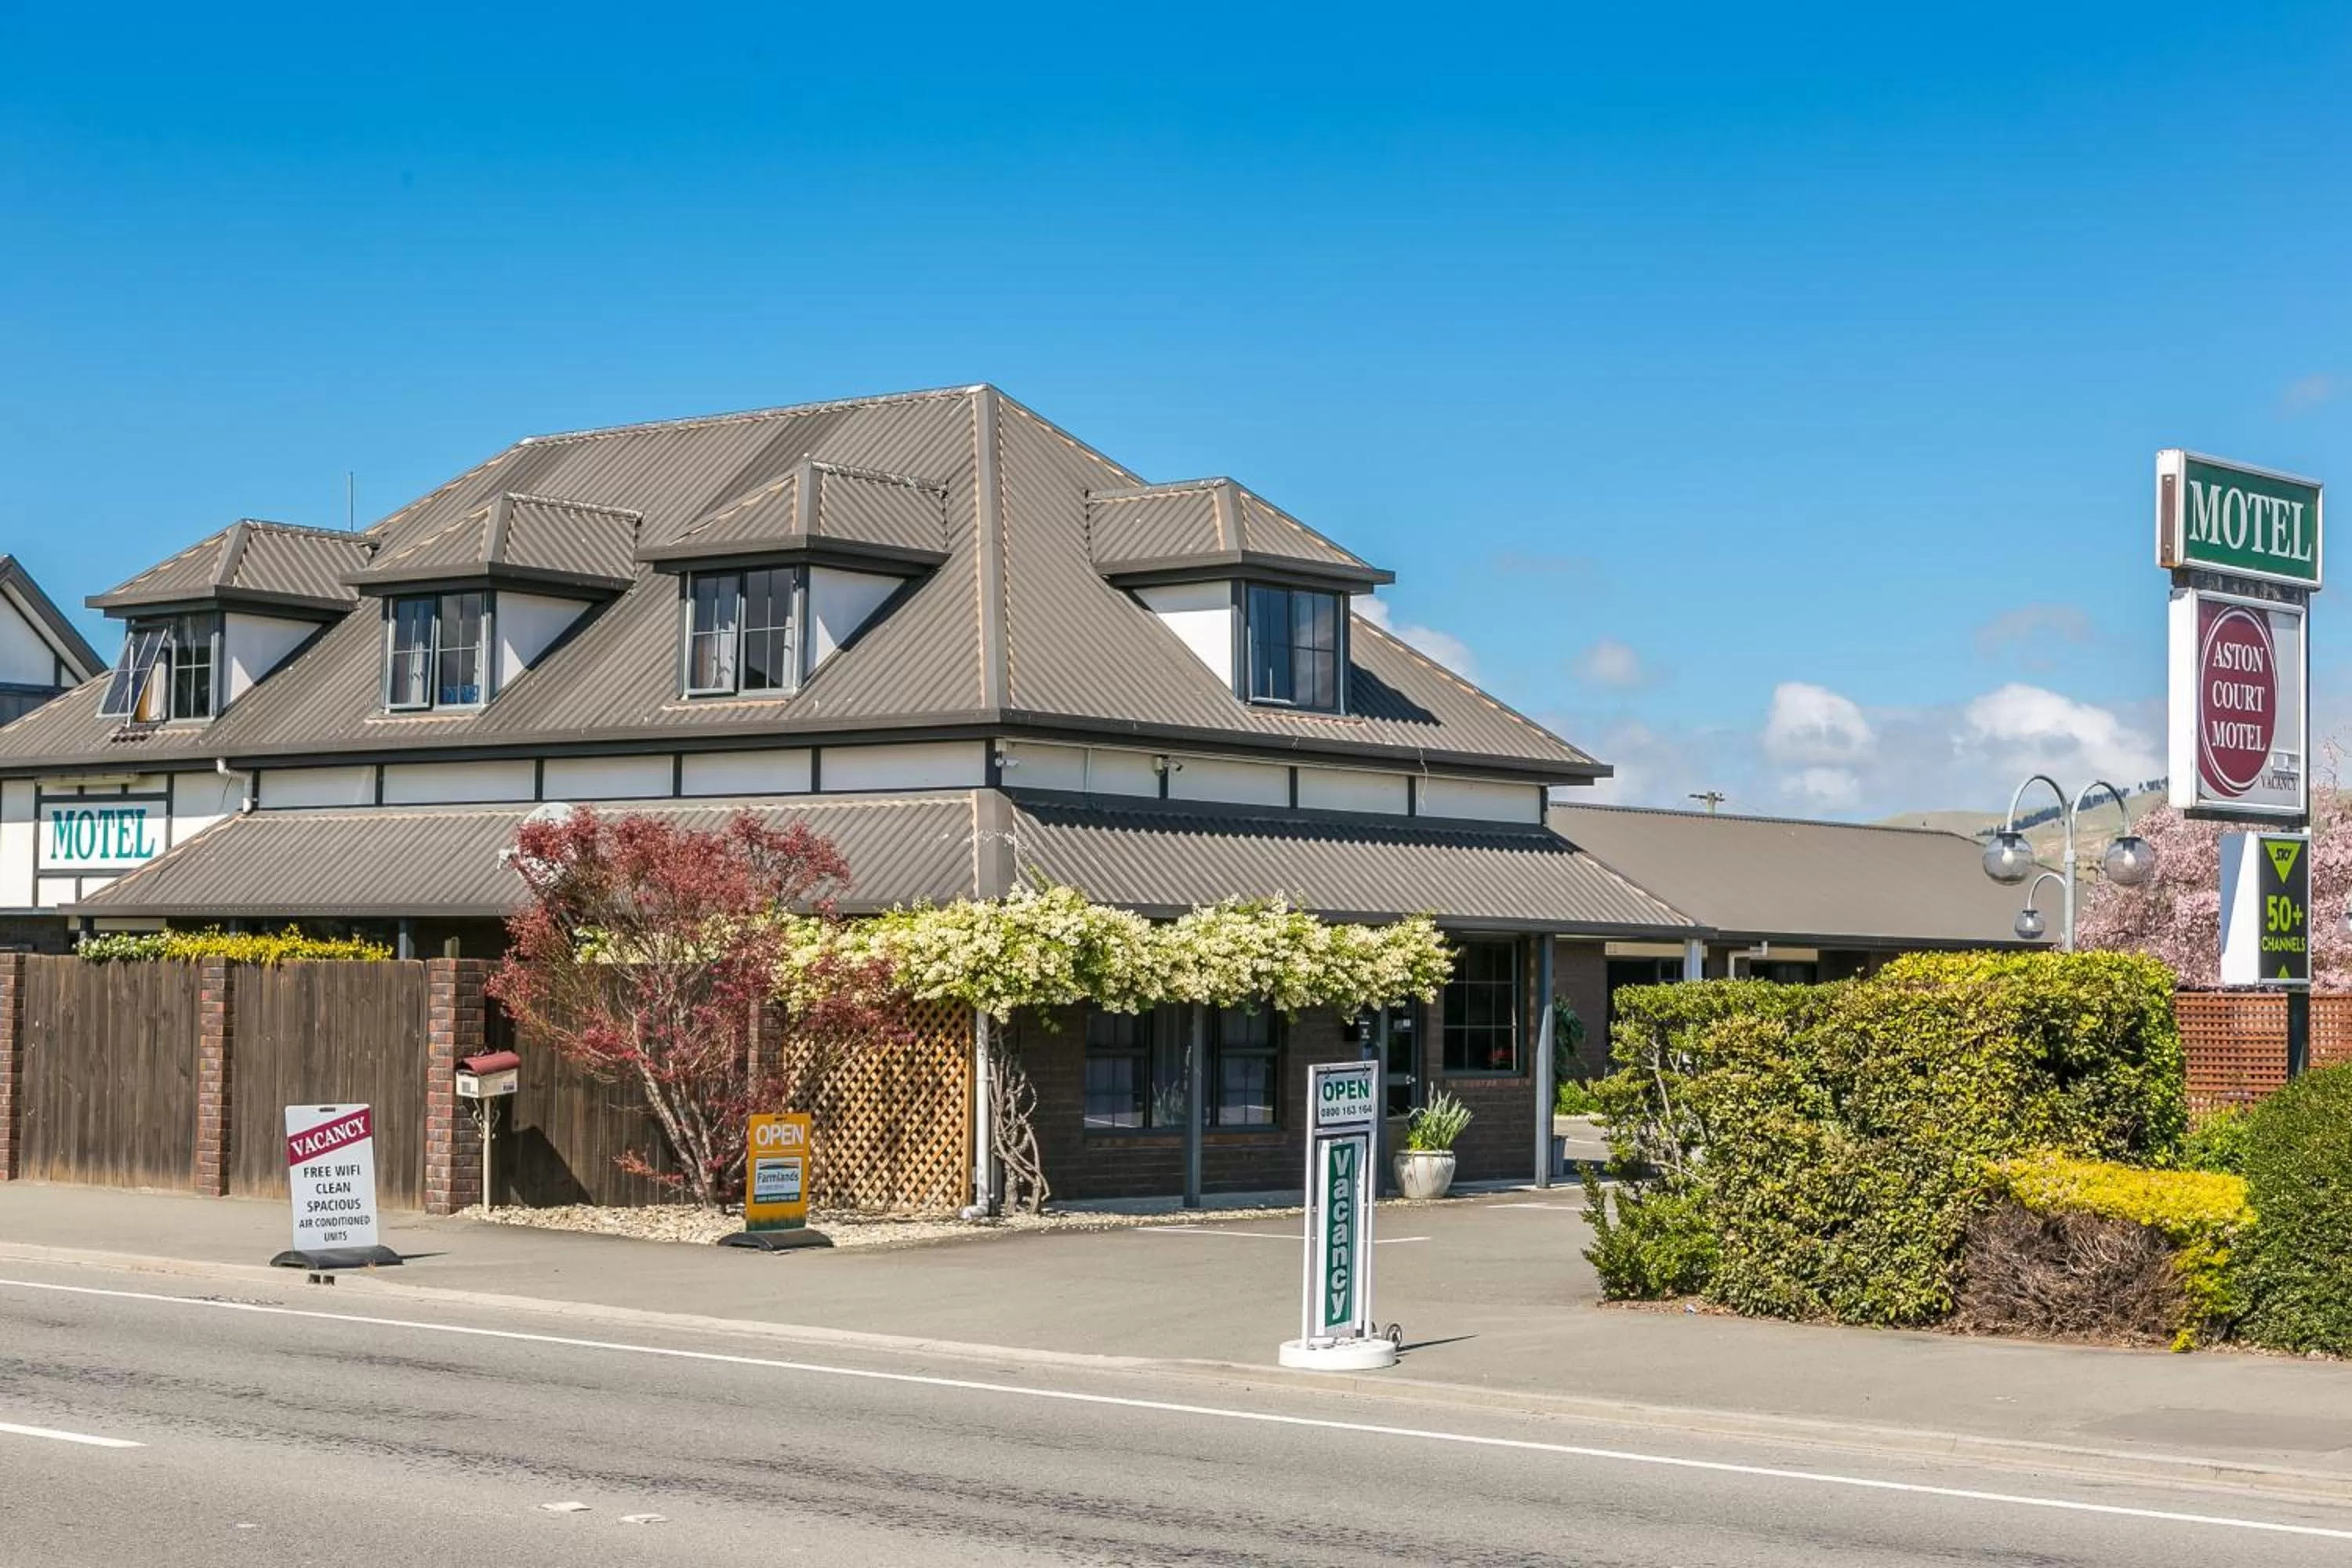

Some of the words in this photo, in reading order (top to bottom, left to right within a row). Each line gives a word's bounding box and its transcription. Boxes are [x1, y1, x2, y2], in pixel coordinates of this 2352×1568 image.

[2189, 480, 2312, 562] MOTEL
[2212, 641, 2265, 673] ASTON
[2212, 680, 2265, 712] COURT
[2212, 720, 2266, 752] MOTEL
[2260, 774, 2297, 791] VACANCY
[50, 808, 155, 859] MOTEL
[2267, 895, 2303, 931] 50+
[2262, 936, 2306, 952] CHANNELS
[1323, 1079, 1369, 1101] OPEN
[1320, 1107, 1340, 1117] 0800
[291, 1116, 366, 1156] VACANCY
[756, 1123, 805, 1145] OPEN
[303, 1166, 331, 1178] FREE
[336, 1164, 361, 1176] WIFI
[757, 1170, 799, 1185] Farmlands
[316, 1182, 350, 1194] CLEAN
[307, 1199, 361, 1212] SPACIOUS
[299, 1219, 313, 1229] AIR
[315, 1215, 371, 1227] CONDITIONED
[324, 1232, 347, 1242] UNITS
